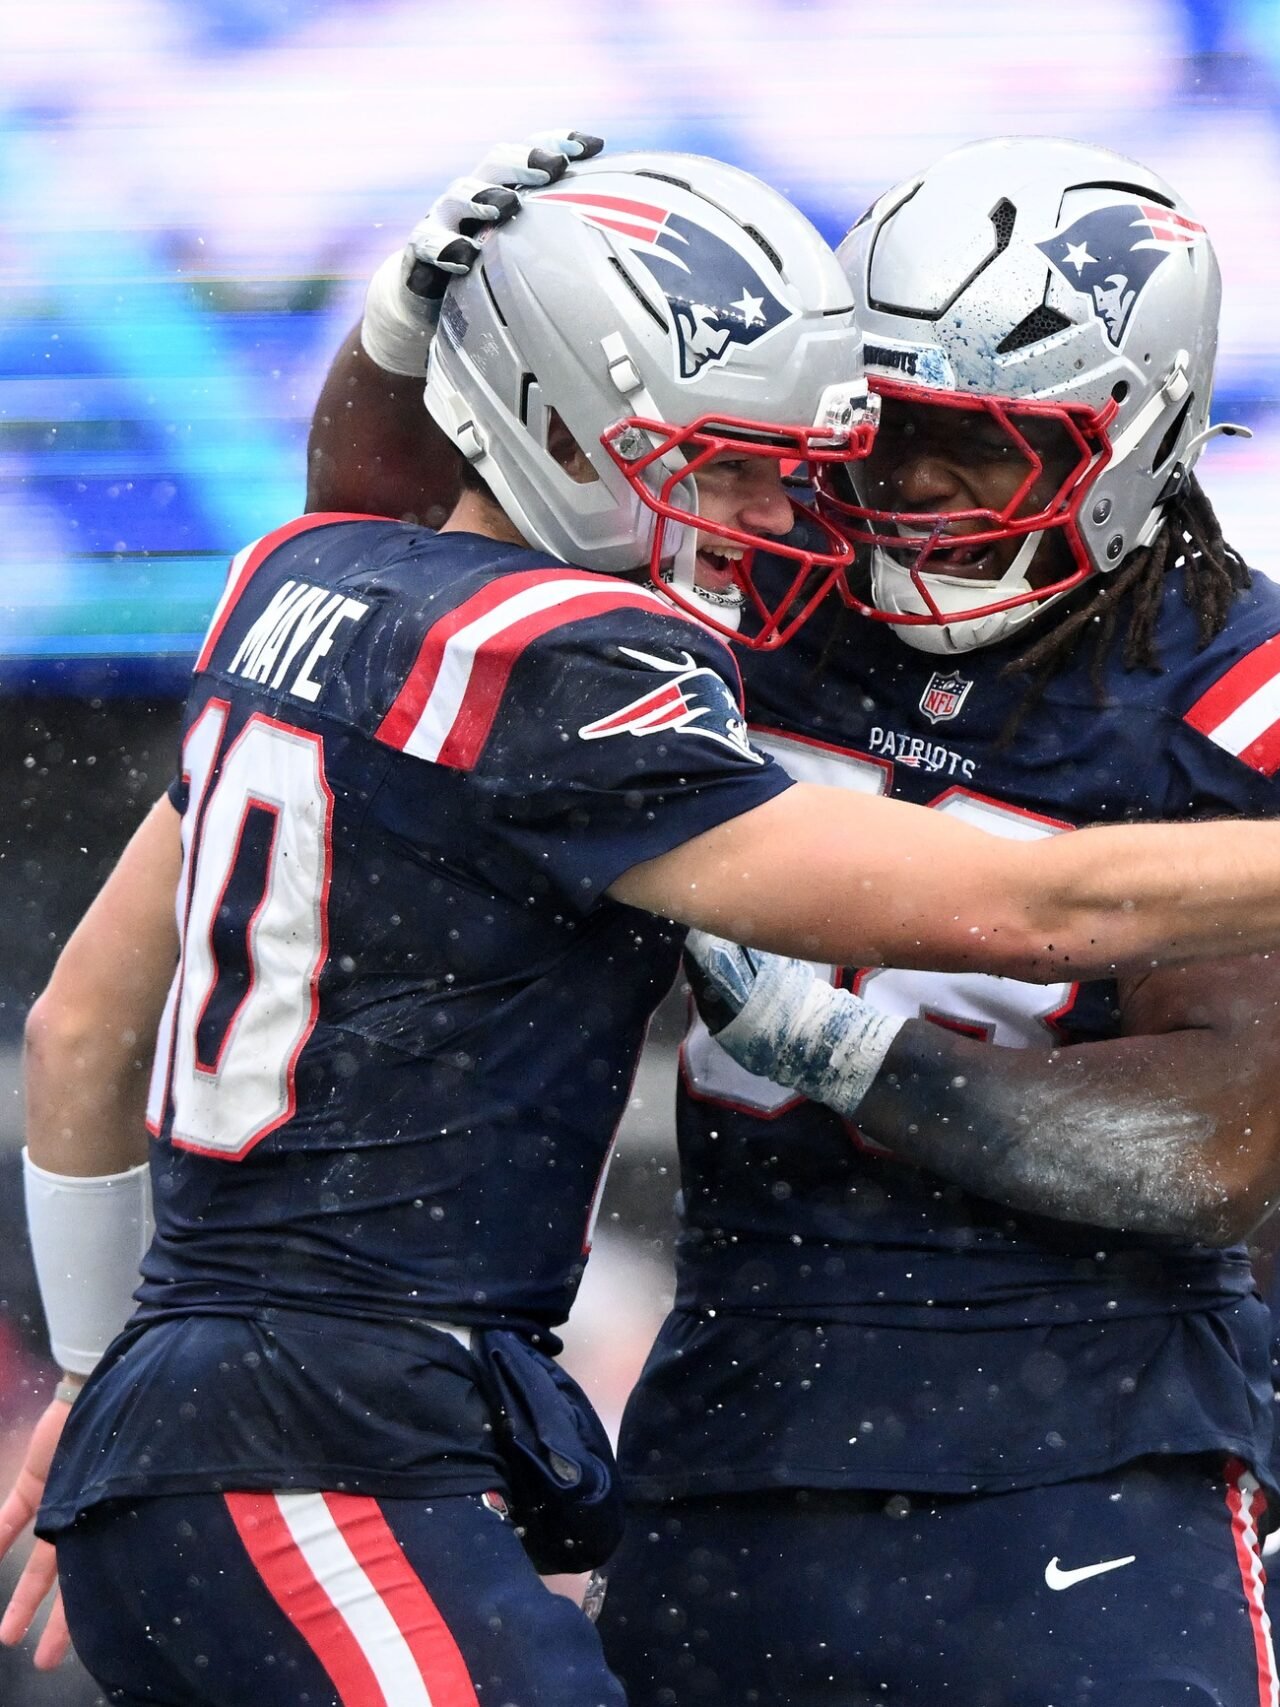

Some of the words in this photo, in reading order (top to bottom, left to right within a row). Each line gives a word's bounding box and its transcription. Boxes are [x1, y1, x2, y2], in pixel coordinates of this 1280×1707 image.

[228, 580, 371, 703] MAYE
[925, 689, 957, 715] NFL
[868, 726, 977, 779] PATRIOTS
[145, 697, 335, 1162] 10
